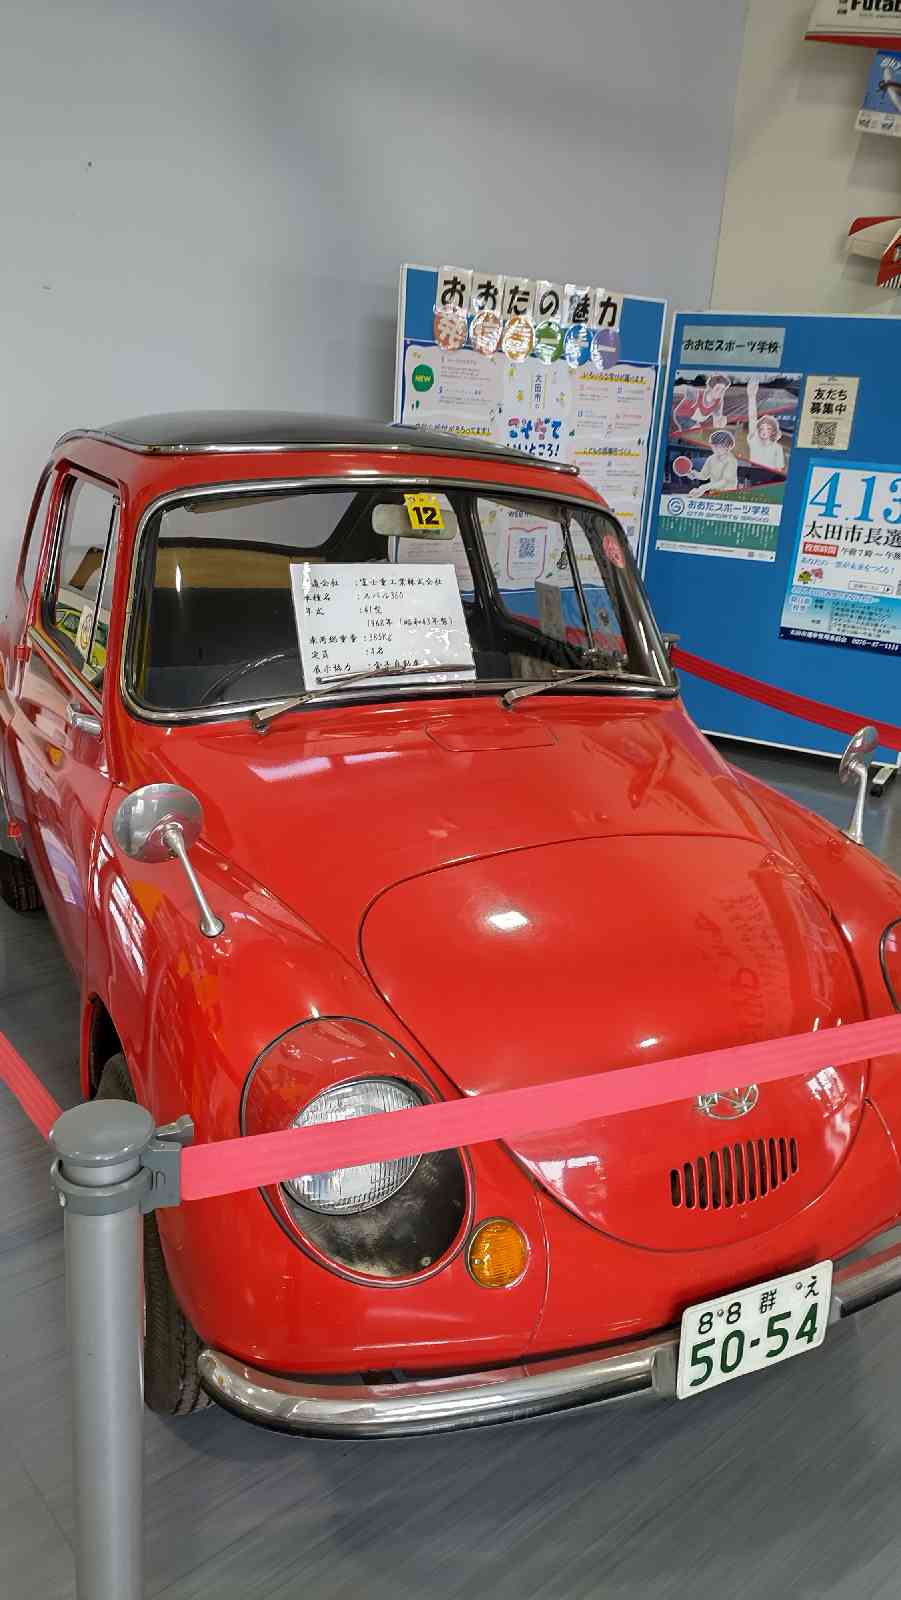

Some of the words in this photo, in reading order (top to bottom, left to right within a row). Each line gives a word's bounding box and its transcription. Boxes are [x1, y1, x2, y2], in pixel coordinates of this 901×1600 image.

[441, 276, 618, 327] おおたの魅力
[684, 339, 780, 353] おおたスポーツ学校
[415, 374, 432, 382] NEW
[813, 388, 848, 401] 友だち
[810, 402, 847, 415] 募集中
[688, 500, 770, 515] おおたスポーツ学校
[413, 506, 440, 525] 12
[760, 1288, 777, 1314] 群
[804, 1275, 820, 1299] え
[689, 1302, 819, 1387] 50-54
